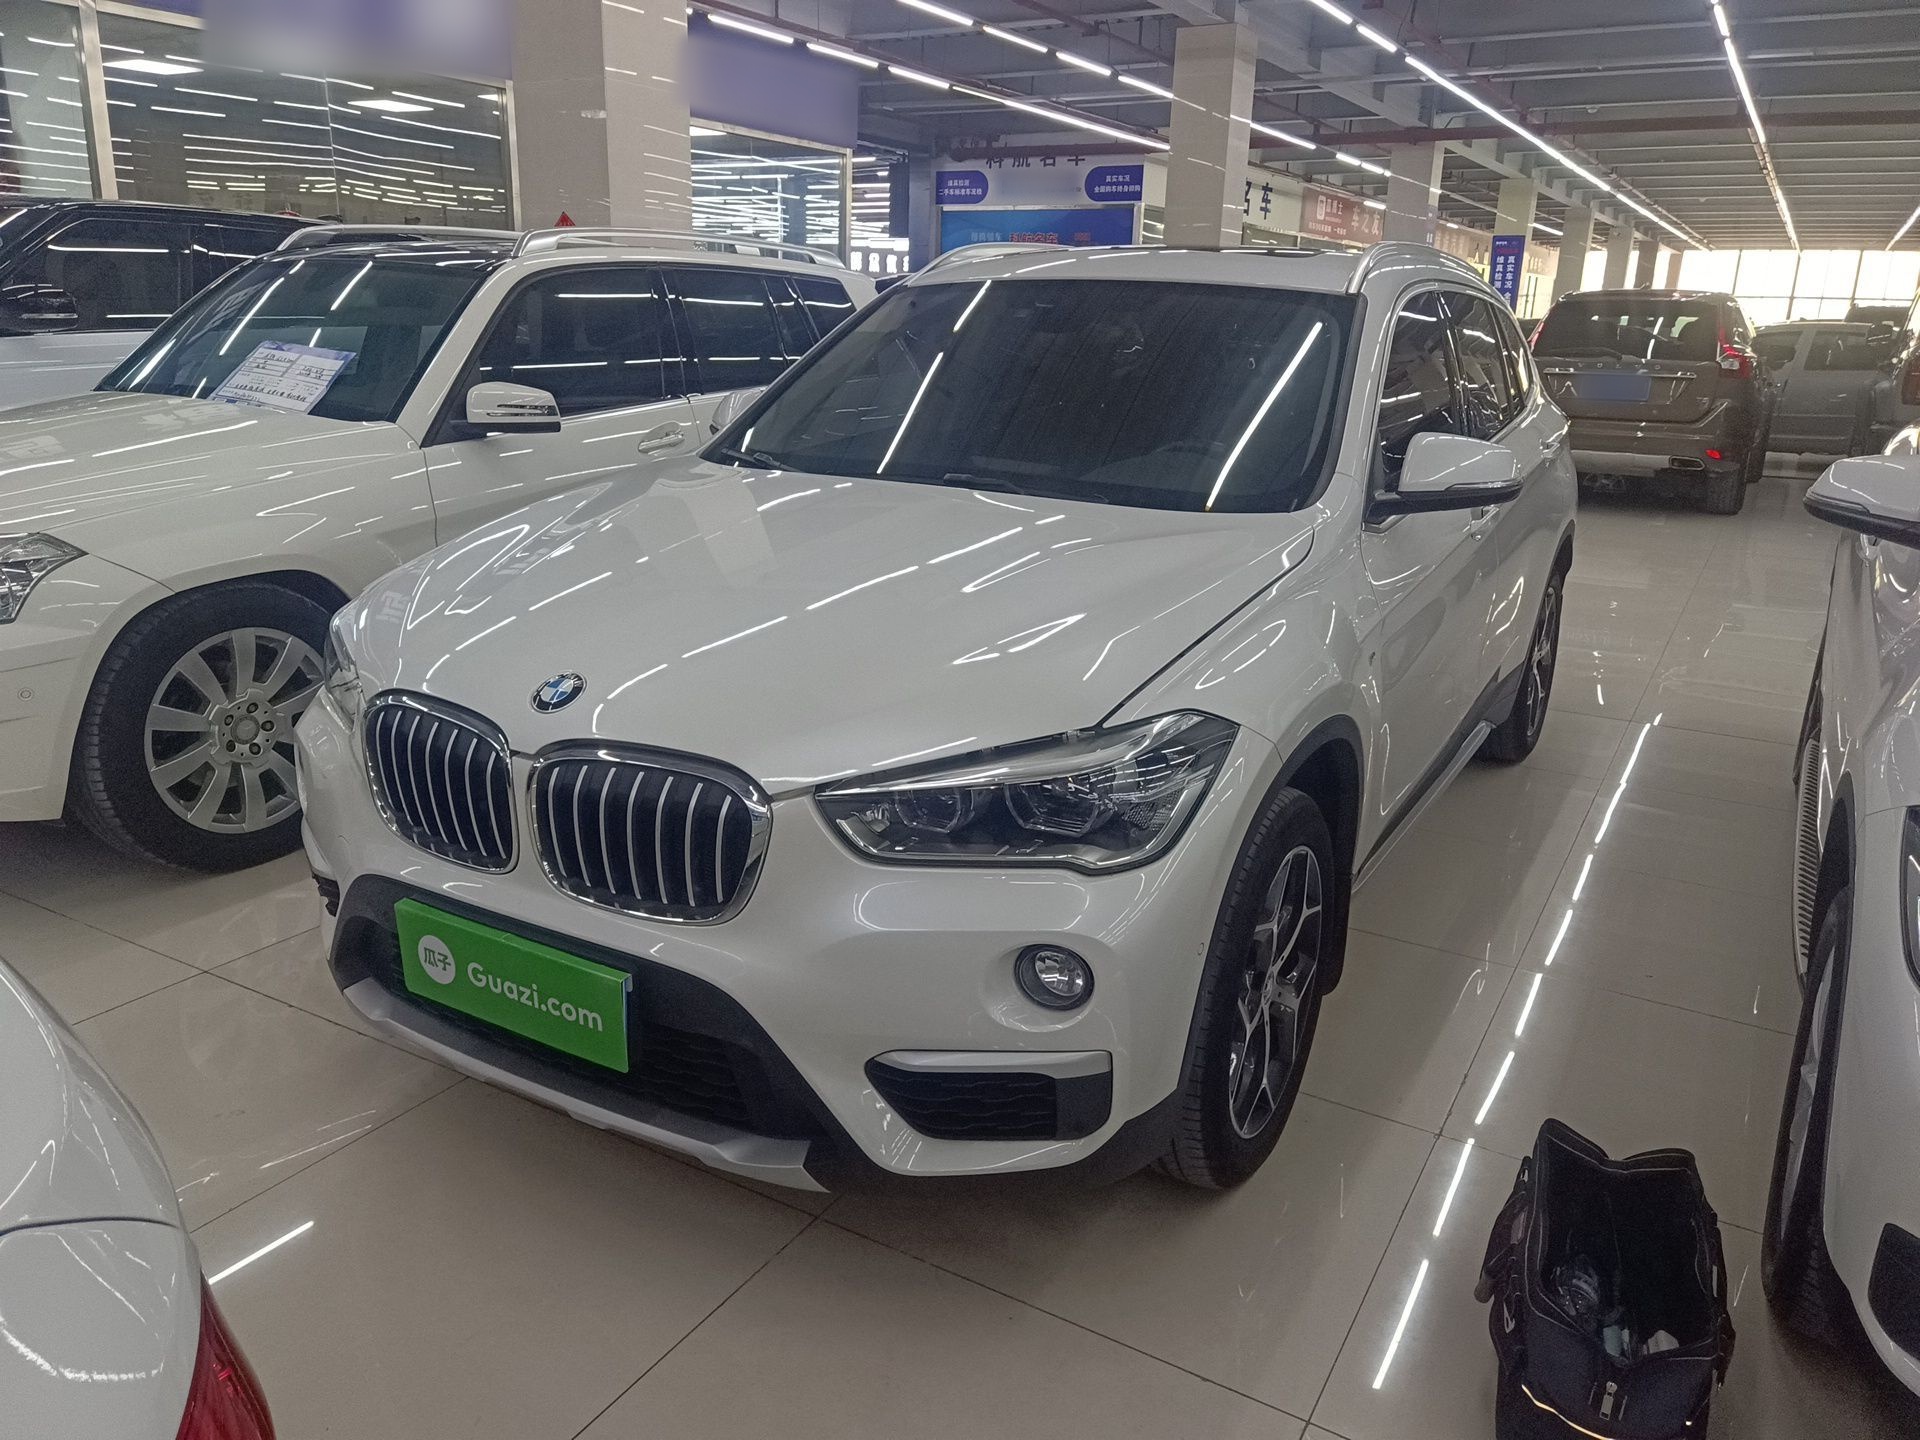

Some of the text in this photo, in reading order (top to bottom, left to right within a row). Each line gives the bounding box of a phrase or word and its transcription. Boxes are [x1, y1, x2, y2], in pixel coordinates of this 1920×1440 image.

[1503, 255, 1516, 289] 真实车况
[423, 946, 452, 973] 瓜子
[467, 961, 604, 1033] Guazi.com
